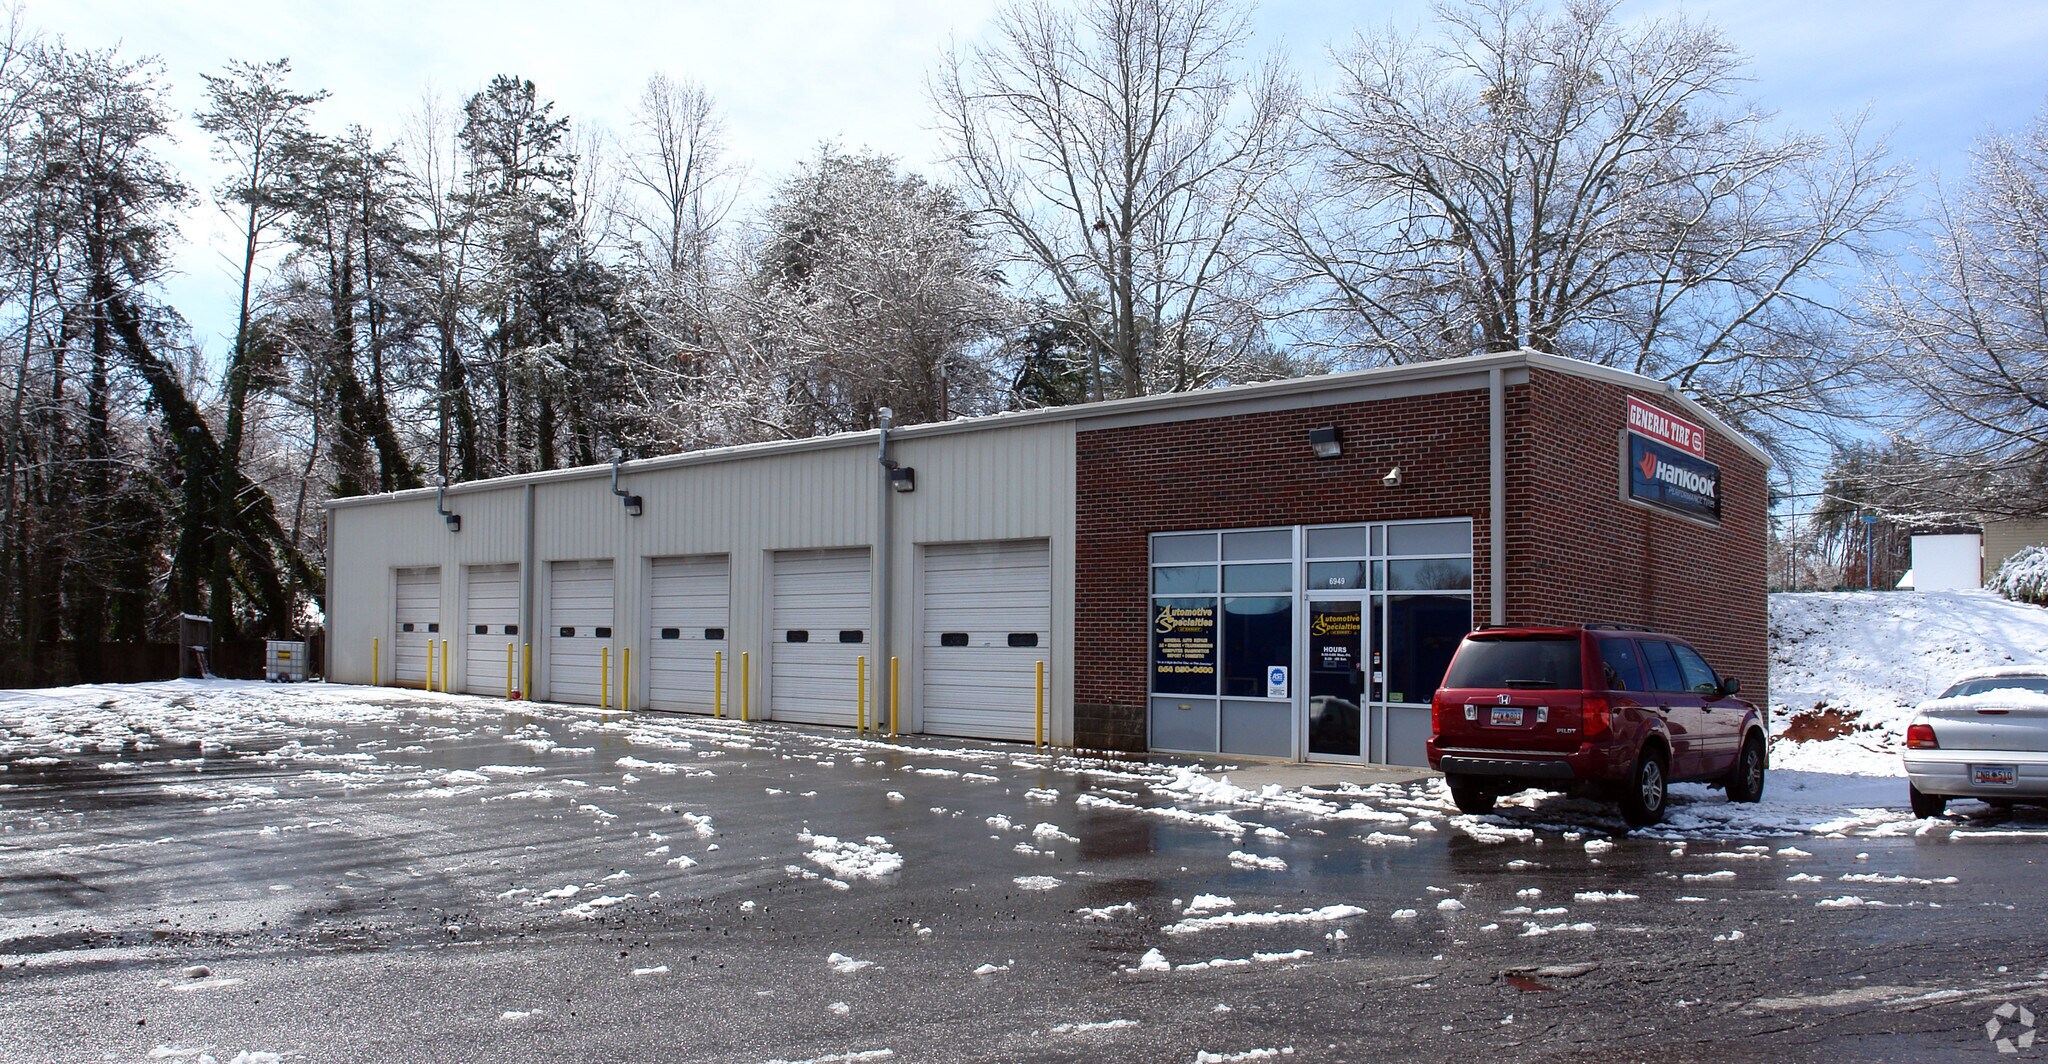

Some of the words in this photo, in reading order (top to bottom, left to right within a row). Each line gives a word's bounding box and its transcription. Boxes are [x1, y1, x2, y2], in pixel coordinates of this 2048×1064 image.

[1629, 404, 1670, 437] GENERAL
[1671, 421, 1691, 447] TIRE
[1155, 604, 1213, 623] Automotive
[1311, 613, 1360, 628] Automotive
[1156, 617, 1213, 634] Specialties
[1312, 623, 1361, 636] Specialties
